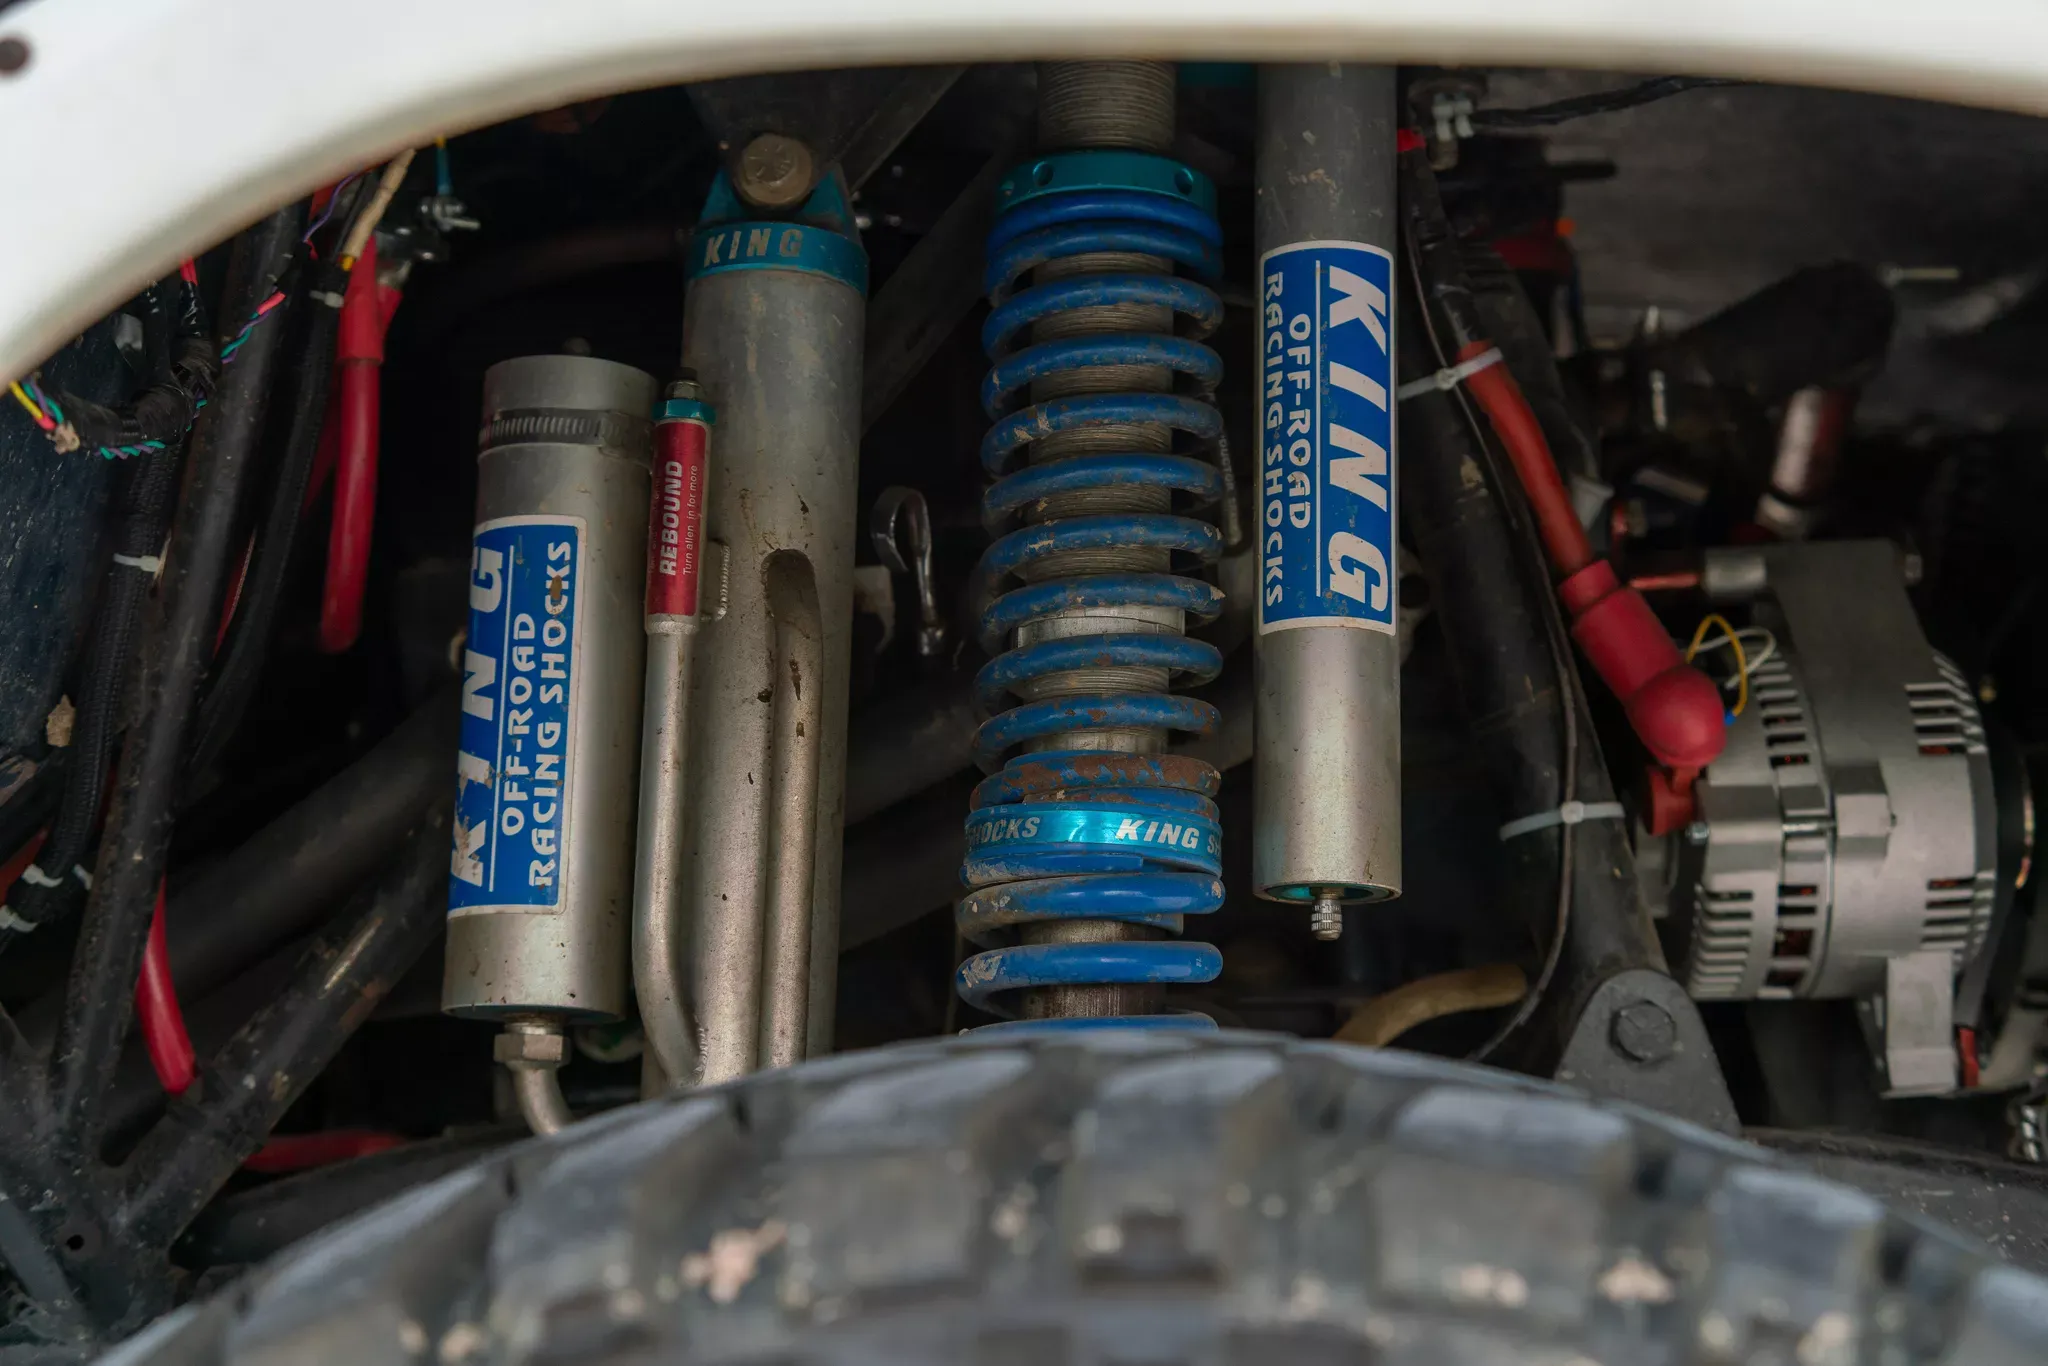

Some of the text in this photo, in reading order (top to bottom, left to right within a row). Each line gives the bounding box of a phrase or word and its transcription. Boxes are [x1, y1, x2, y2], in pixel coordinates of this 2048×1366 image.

[704, 228, 803, 268] KING
[659, 461, 683, 576] REBOUND
[683, 465, 698, 576] Turn allen in for more
[1266, 271, 1284, 607] RACING SHOCKS
[1289, 313, 1311, 529] OFF-ROAD
[1329, 265, 1389, 612] KING
[451, 546, 503, 888] KING
[501, 613, 536, 836] OFF-ROAD
[529, 540, 571, 887] RACING SHOCKS
[1115, 818, 1200, 849] KING
